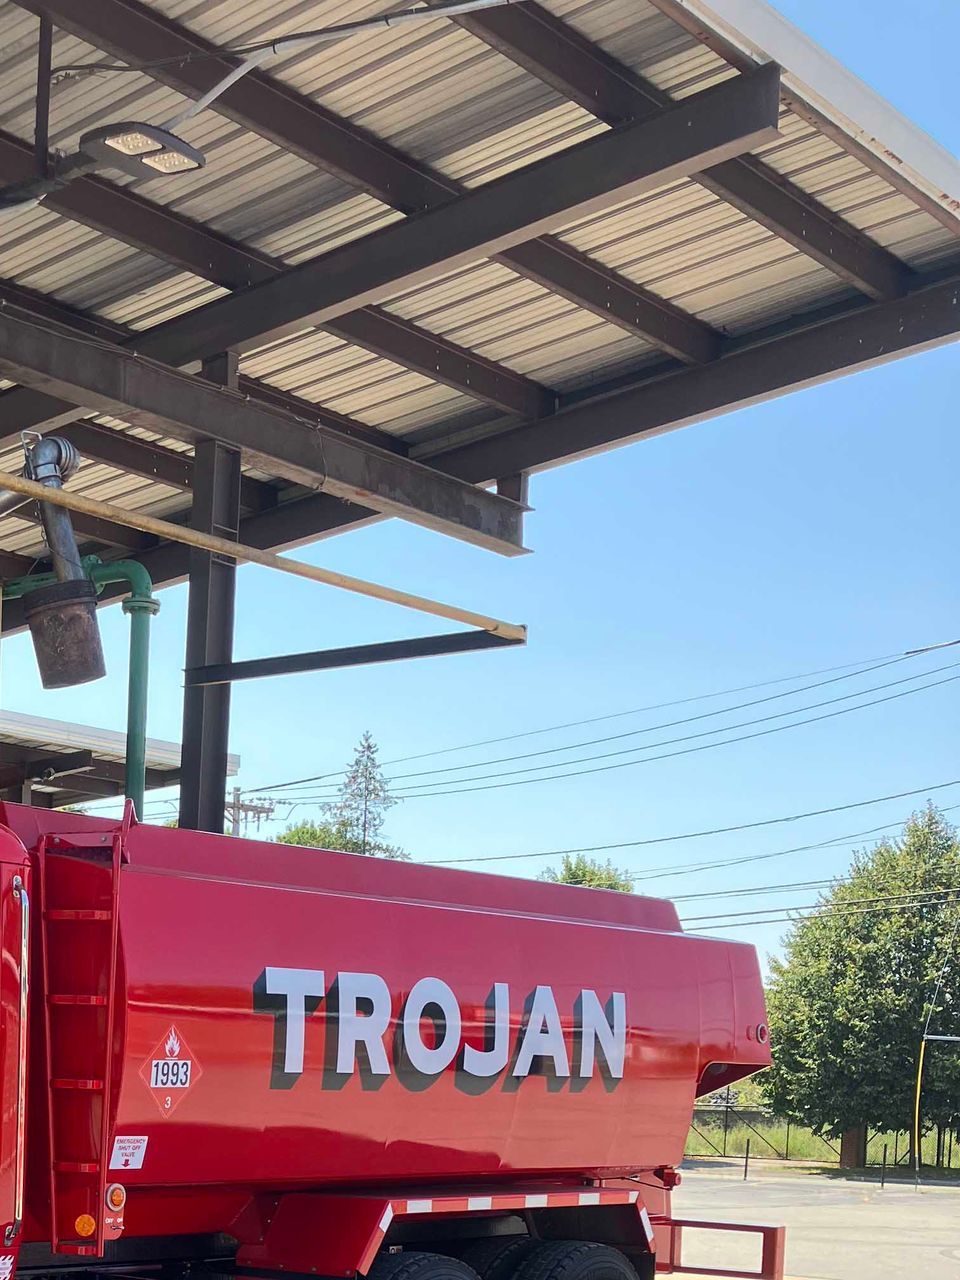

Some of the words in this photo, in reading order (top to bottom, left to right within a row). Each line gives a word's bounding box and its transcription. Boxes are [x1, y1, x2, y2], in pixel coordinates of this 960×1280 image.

[254, 966, 627, 1092] TROJAN
[153, 1062, 189, 1086] 1993
[164, 1096, 172, 1109] 3
